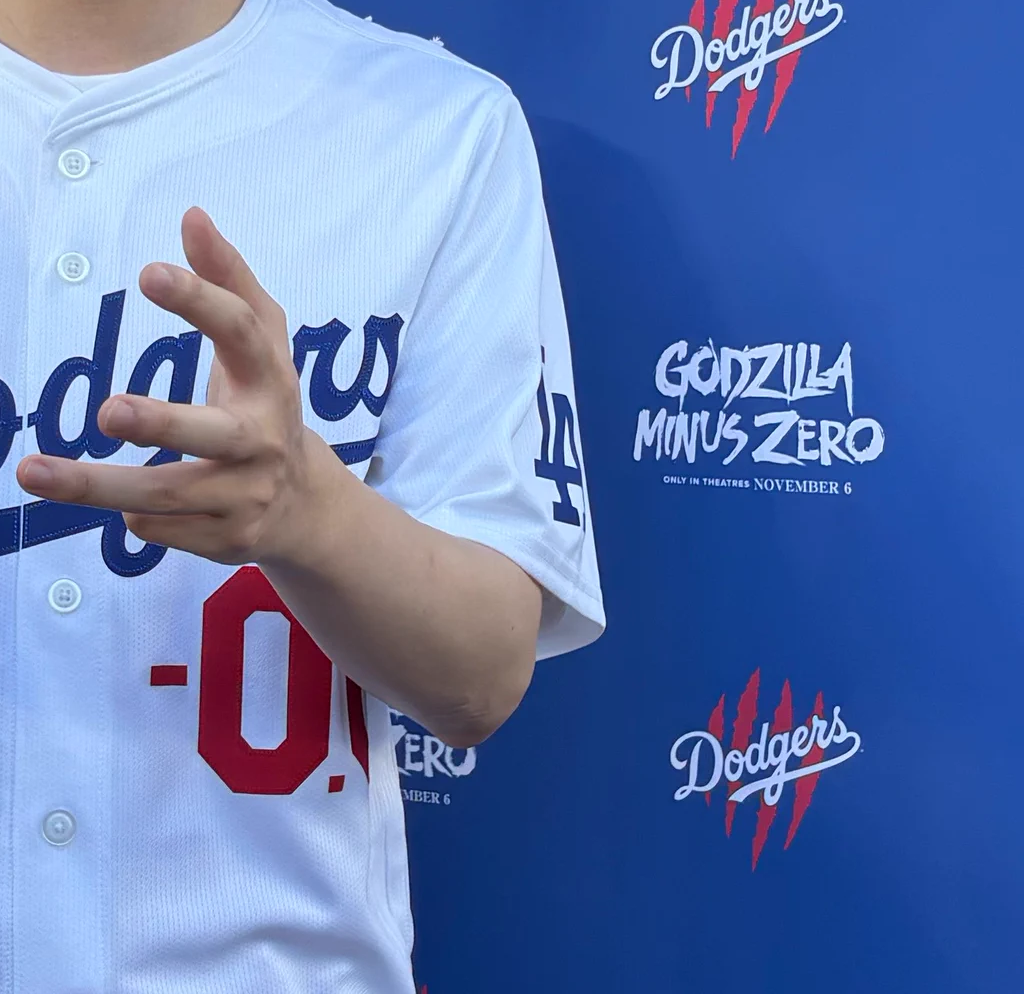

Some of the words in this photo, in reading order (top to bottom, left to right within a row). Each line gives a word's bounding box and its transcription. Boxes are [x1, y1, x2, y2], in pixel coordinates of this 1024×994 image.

[655, 338, 854, 417] GODZILLA
[633, 407, 749, 465] MINUS
[751, 409, 885, 466] ZERO
[663, 475, 686, 485] ONLY
[689, 477, 700, 486] IN
[703, 477, 750, 488] THEATRES
[754, 478, 840, 494] NOVEMBER
[844, 482, 852, 495] 6
[390, 724, 477, 777] ERO
[670, 705, 861, 806] Dodgers
[401, 788, 441, 804] MBER
[443, 793, 451, 806] 6
